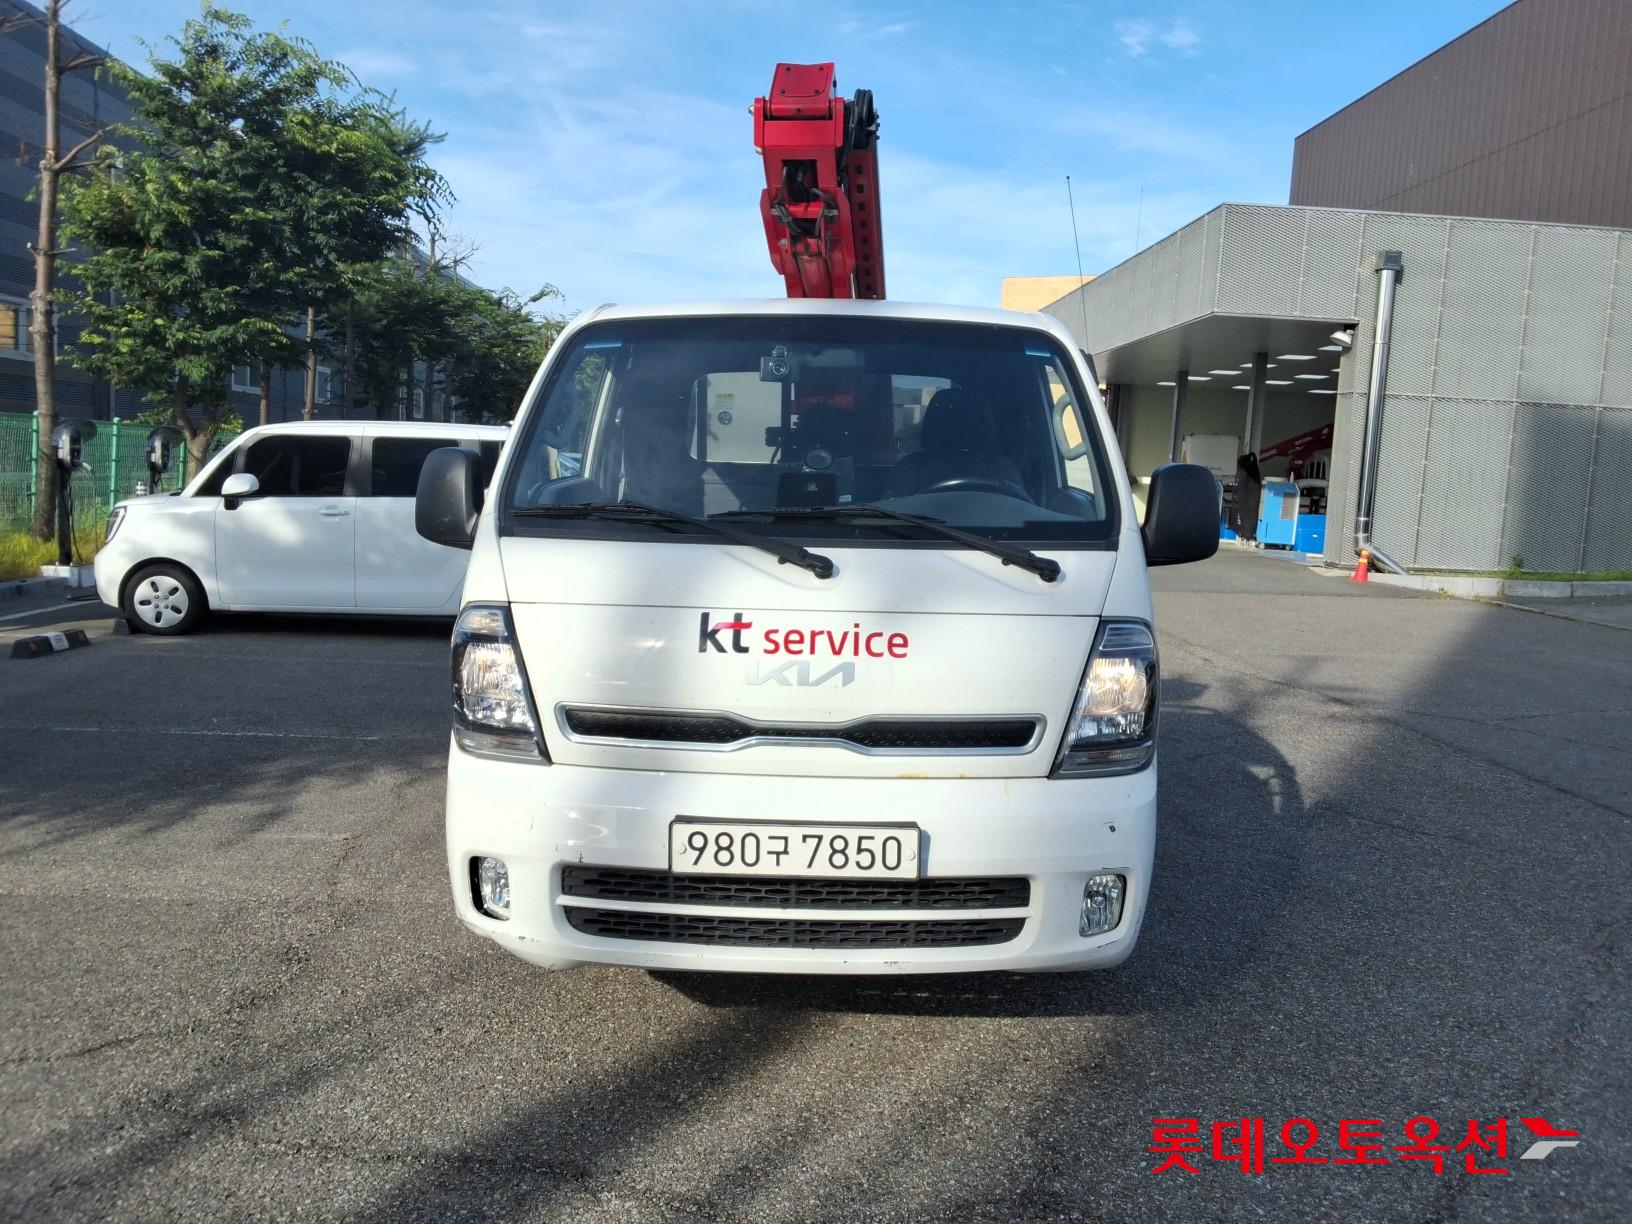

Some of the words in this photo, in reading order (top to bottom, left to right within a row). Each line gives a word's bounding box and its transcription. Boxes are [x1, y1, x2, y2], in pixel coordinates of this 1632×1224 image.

[698, 611, 753, 654] kt
[763, 623, 909, 659] service
[745, 660, 856, 688] KIA
[801, 834, 902, 871] 7850
